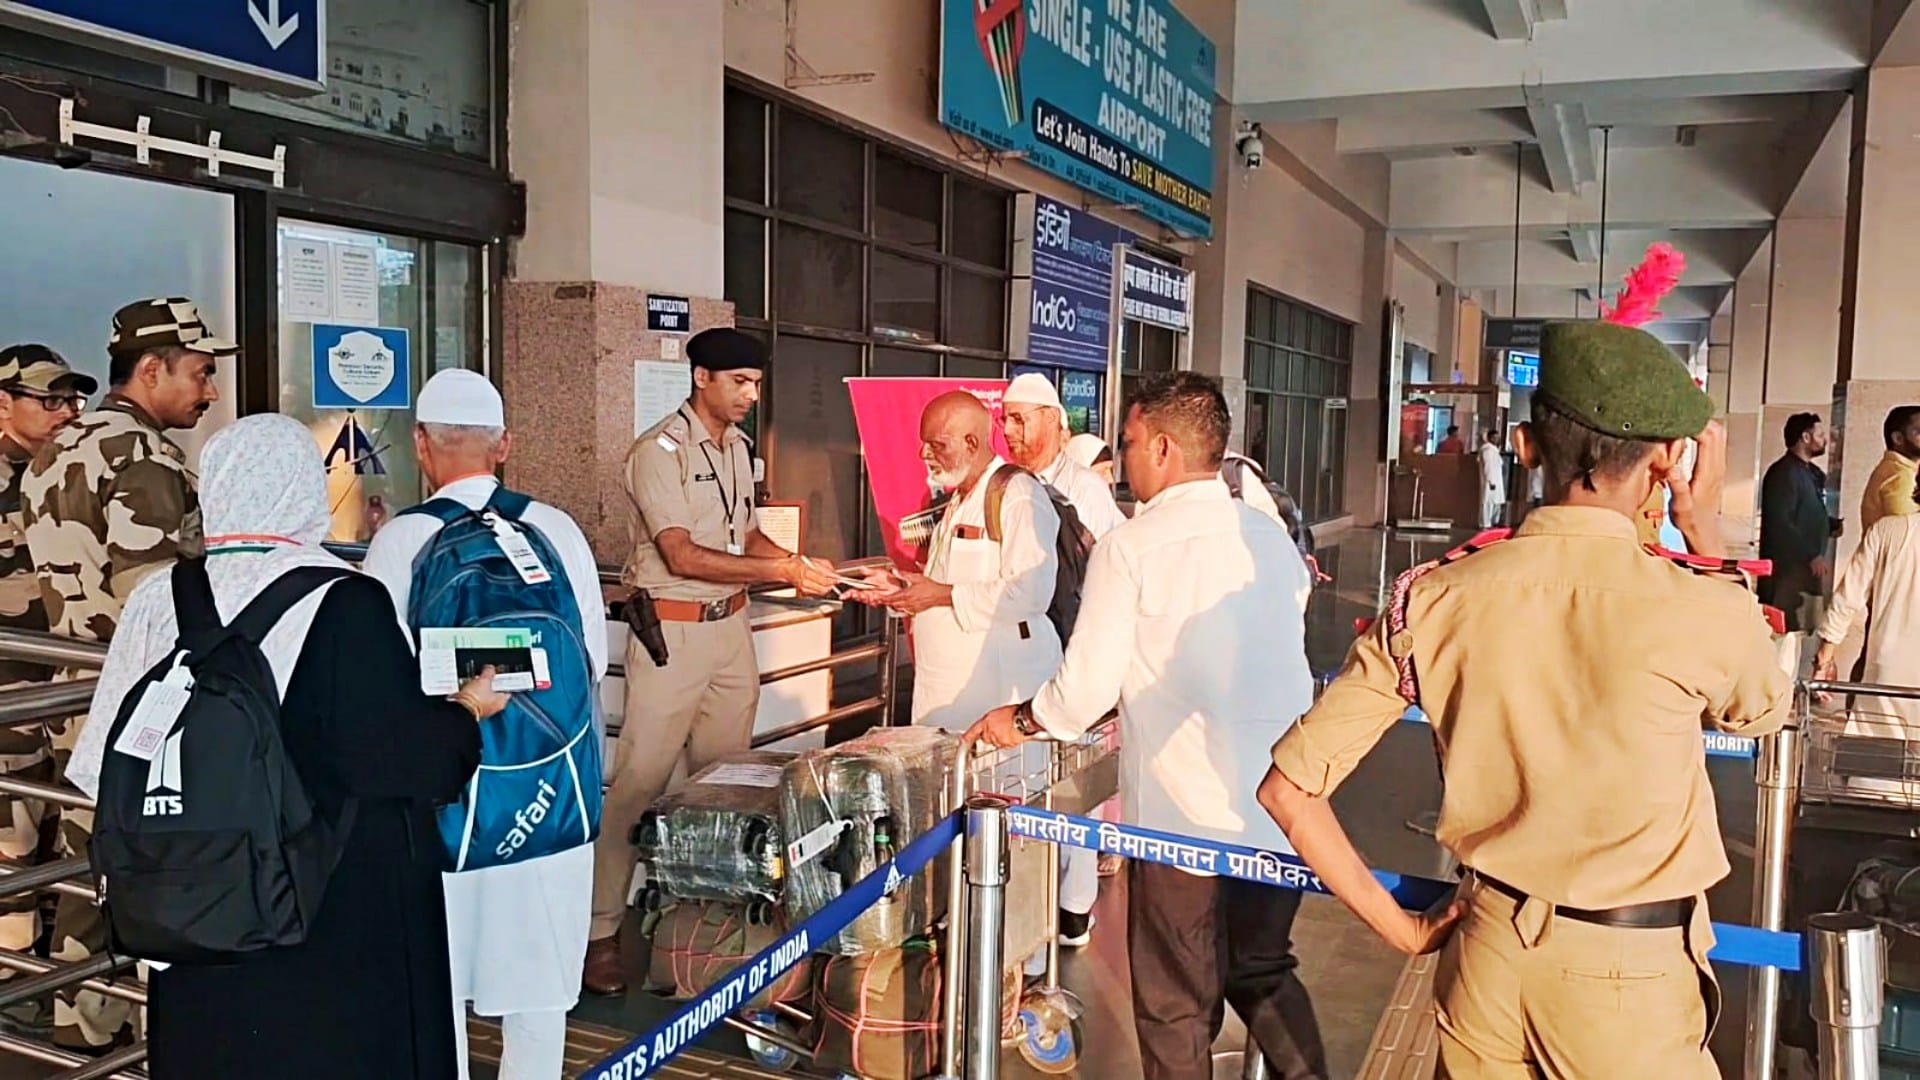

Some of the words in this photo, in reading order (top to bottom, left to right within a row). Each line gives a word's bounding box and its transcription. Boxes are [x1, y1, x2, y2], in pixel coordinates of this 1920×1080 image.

[1136, 0, 1167, 59] ARE
[1029, 0, 1092, 67] SINGLE
[1104, 24, 1132, 95] USE
[1134, 48, 1182, 130] PLASTIC
[1184, 86, 1212, 148] FREE
[1097, 92, 1167, 161] AIRPORT
[1037, 106, 1063, 143] Let's
[1065, 122, 1087, 155] Join
[1089, 134, 1118, 171] Hands
[1120, 153, 1131, 177] To
[1132, 159, 1153, 188] SAVE
[1154, 170, 1187, 205] MOTHER
[1188, 187, 1211, 217] EARTH
[1036, 203, 1071, 251] इंडिगो
[649, 298, 689, 314] SANITIZATION
[660, 314, 678, 328] POINT
[1032, 289, 1076, 332] IndiGo
[143, 795, 183, 816] BTS
[496, 778, 557, 860] safari
[1013, 812, 1091, 847] भारतीय
[1097, 822, 1220, 871] विमानपत्तन
[652, 973, 746, 1066] AUTHORITY
[749, 957, 769, 993] OF
[769, 930, 809, 979] INDIA
